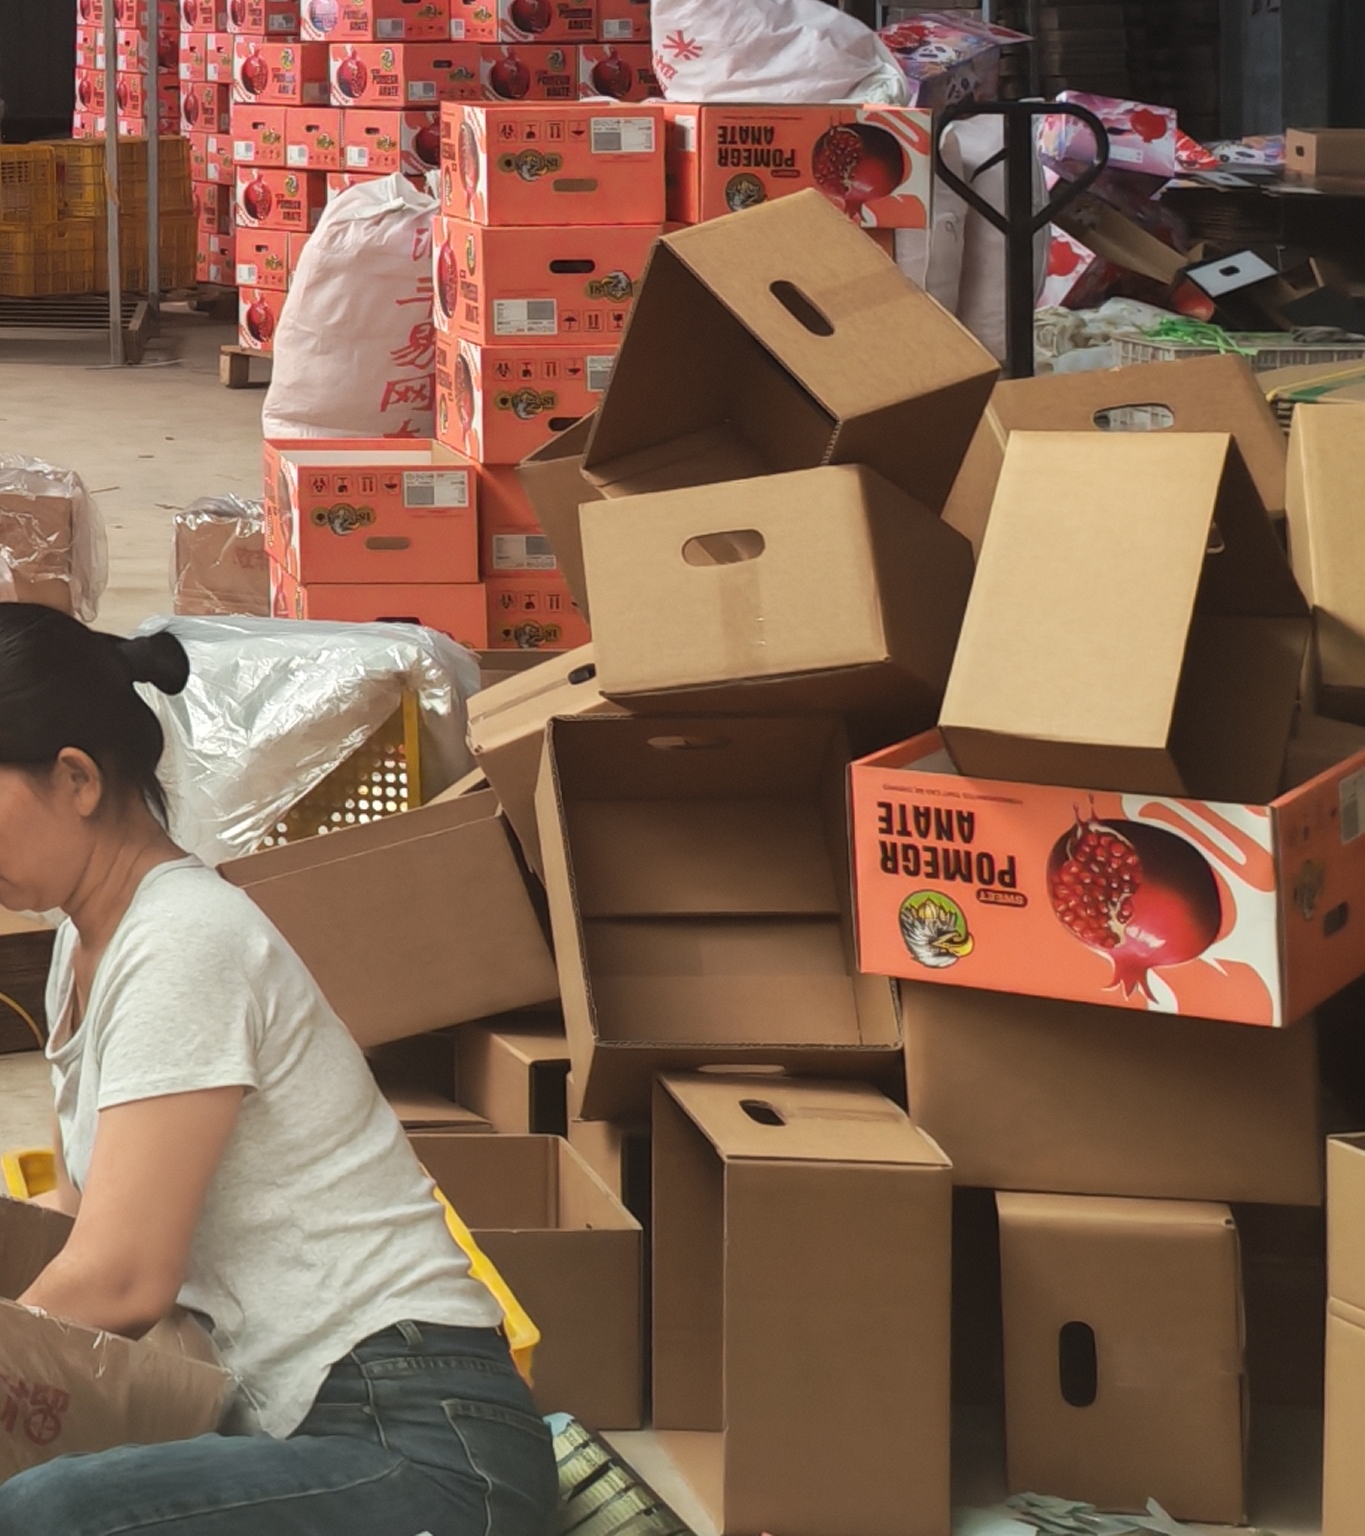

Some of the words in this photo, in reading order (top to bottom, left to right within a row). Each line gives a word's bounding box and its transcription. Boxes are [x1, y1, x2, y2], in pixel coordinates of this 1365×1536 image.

[716, 125, 775, 146] ANATE
[716, 147, 796, 168] POMEGR
[877, 801, 975, 842] ANATE
[879, 841, 1017, 889] POMEGR
